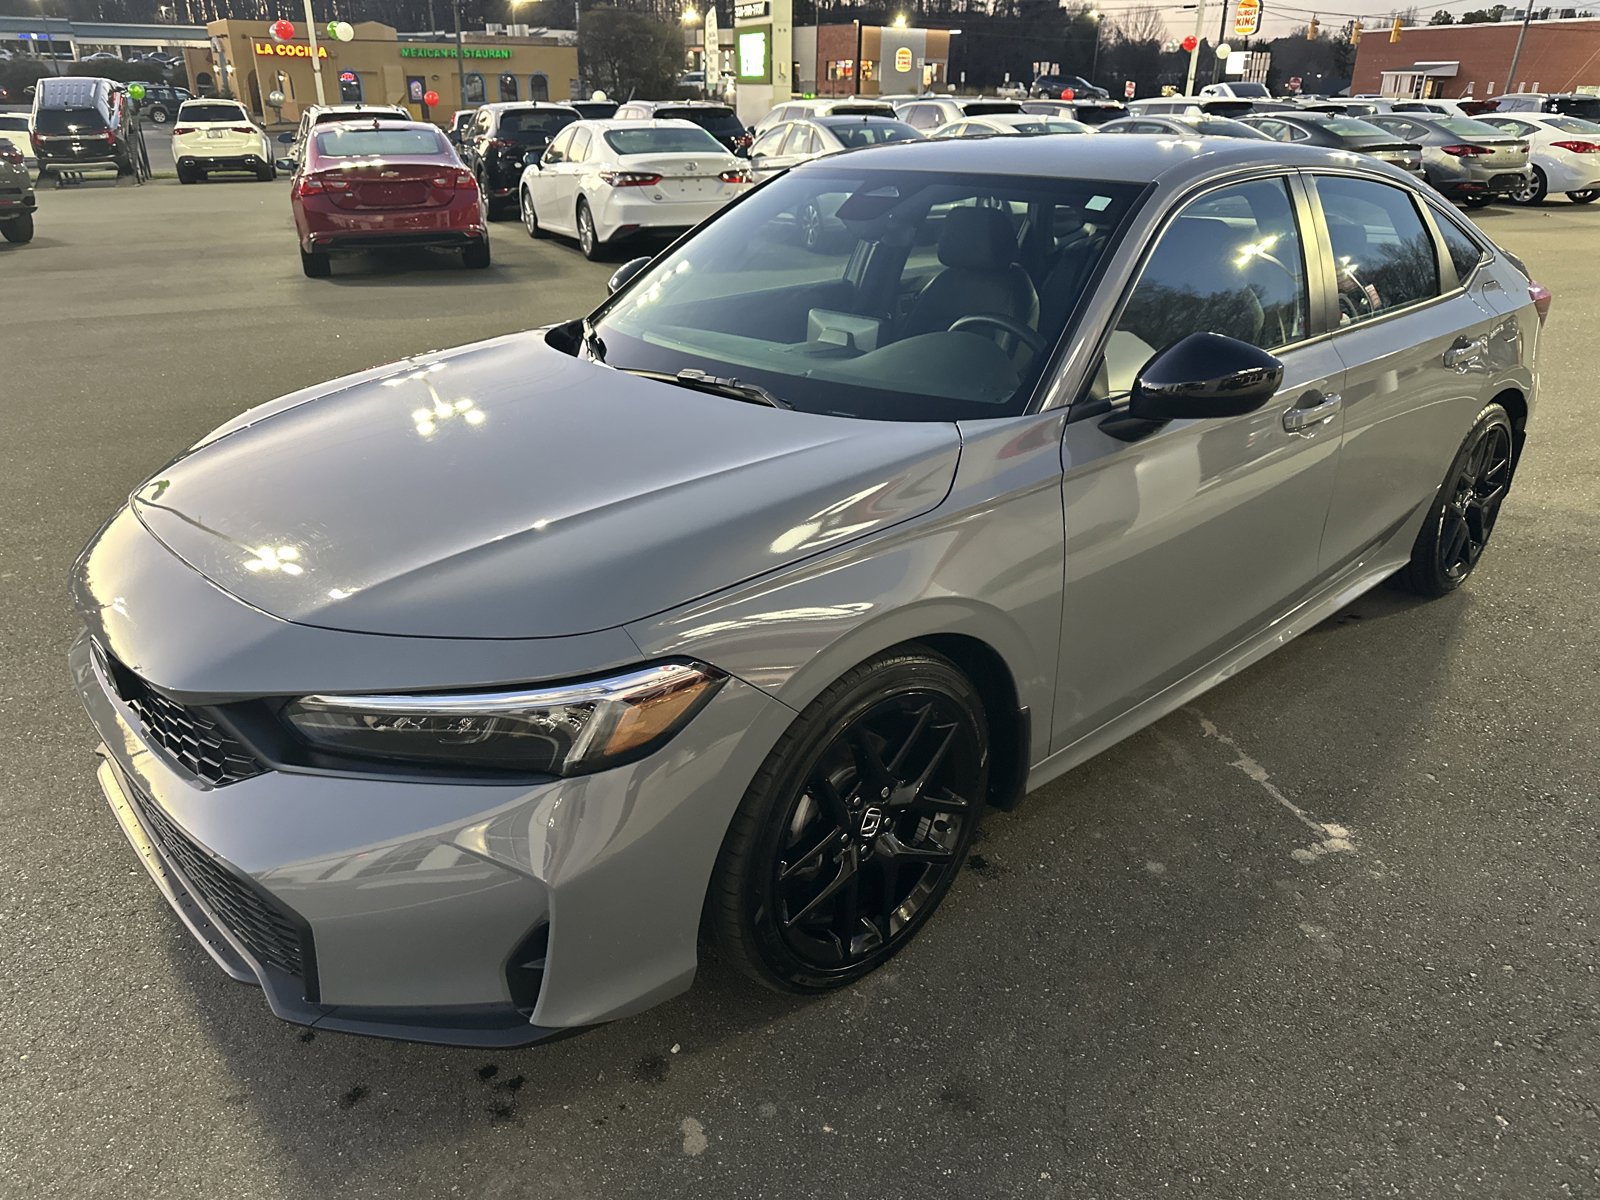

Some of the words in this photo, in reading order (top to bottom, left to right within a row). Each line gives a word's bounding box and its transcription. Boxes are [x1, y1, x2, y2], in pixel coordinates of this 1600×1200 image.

[1236, 17, 1255, 26] KING
[255, 43, 274, 55] LA
[401, 48, 448, 57] MEXICAN
[450, 48, 513, 59] RSTAURANT
